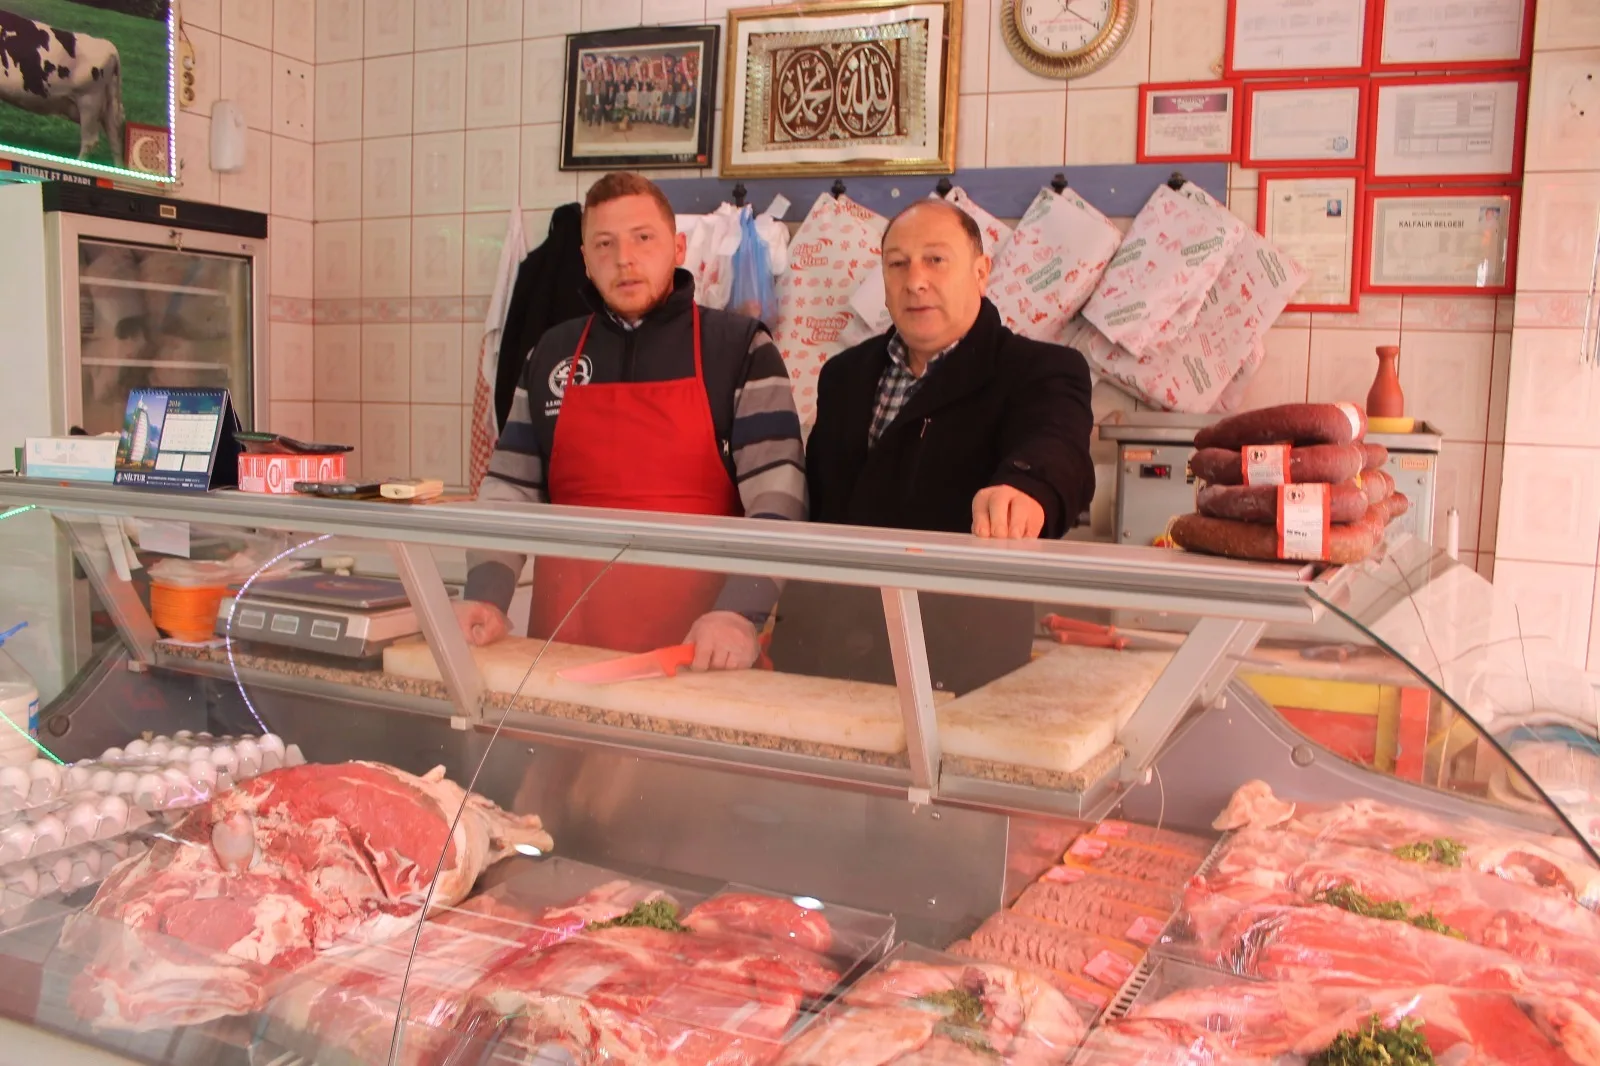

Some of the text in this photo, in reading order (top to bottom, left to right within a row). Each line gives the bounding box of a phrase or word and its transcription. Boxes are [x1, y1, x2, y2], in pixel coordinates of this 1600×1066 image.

[1026, 6, 1033, 16] 9
[1031, 24, 1038, 35] 8
[1061, 41, 1068, 52] 6
[1399, 220, 1432, 228] KALFALIK
[123, 472, 146, 482] NİLTUR
